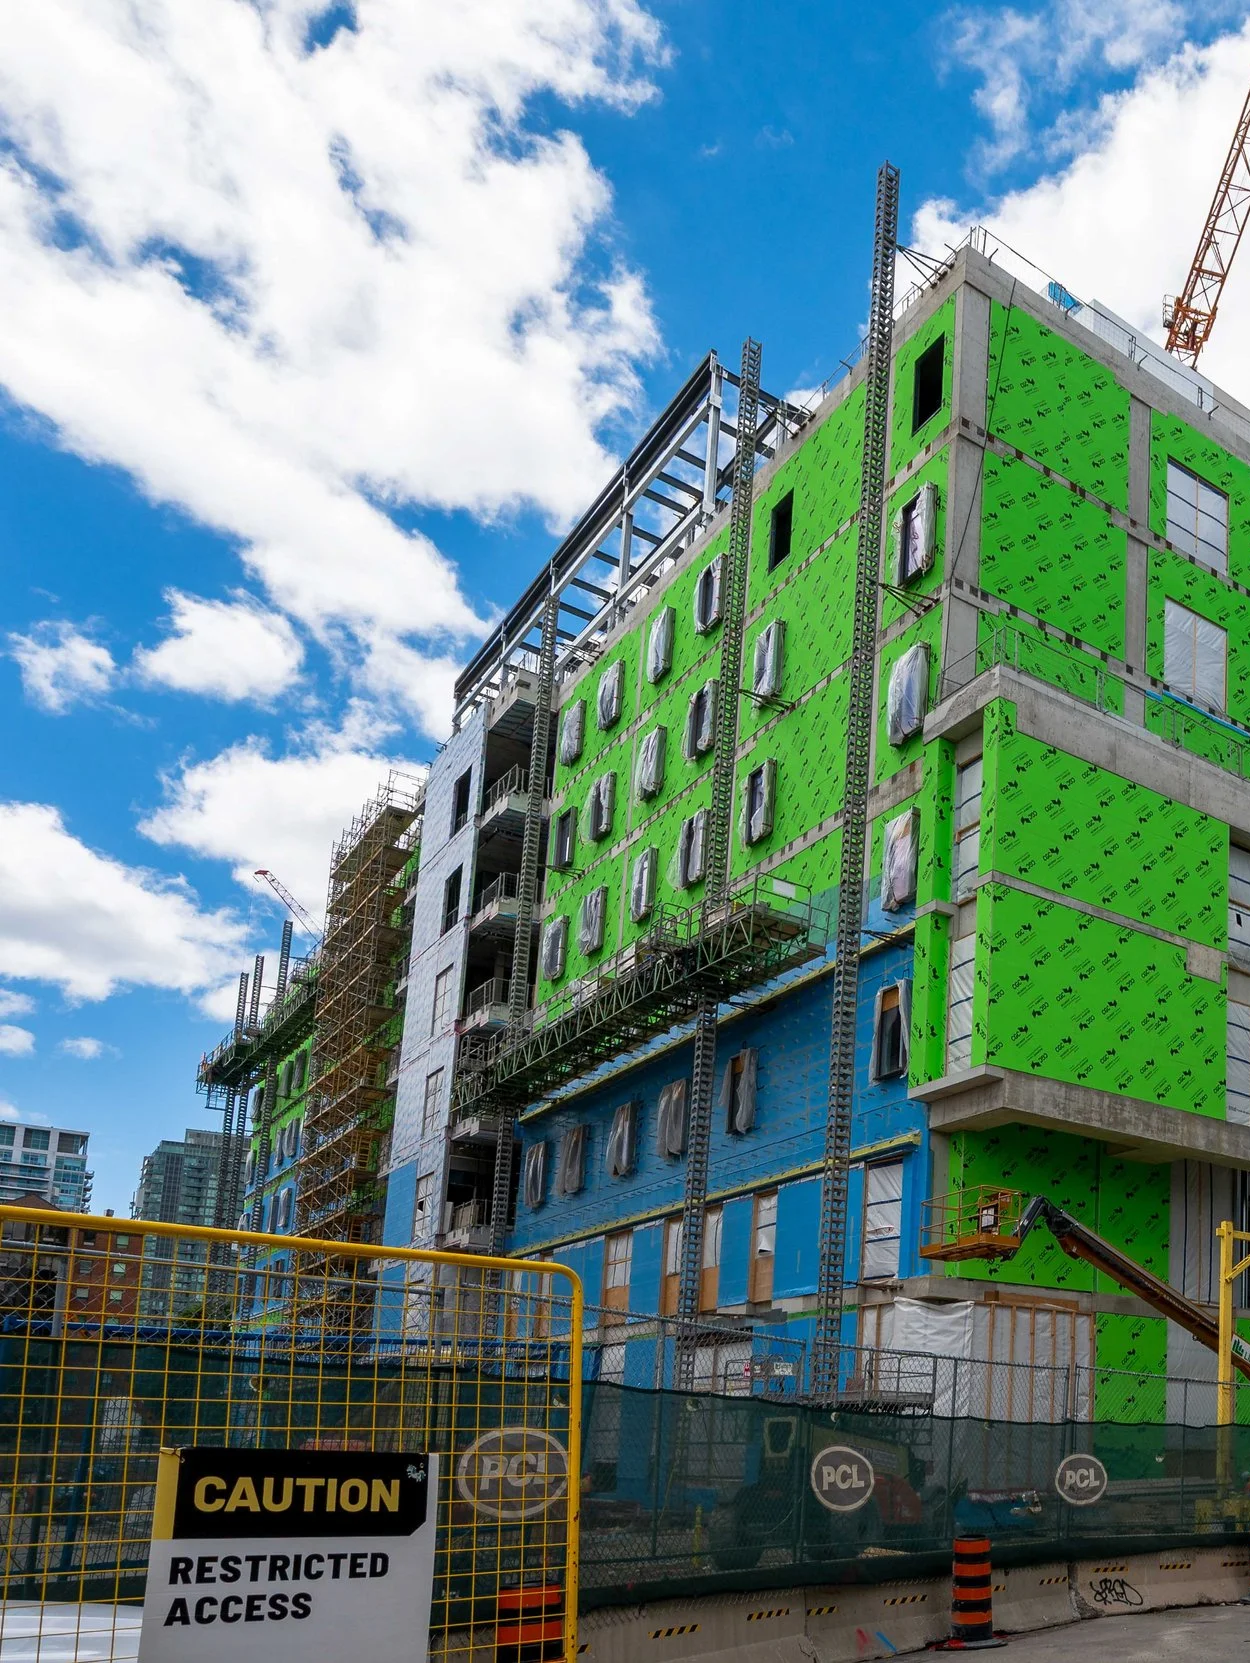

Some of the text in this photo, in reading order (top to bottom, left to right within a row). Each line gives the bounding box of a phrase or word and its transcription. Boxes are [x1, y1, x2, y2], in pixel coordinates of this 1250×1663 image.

[480, 1451, 549, 1492] PCL
[822, 1464, 865, 1491] PCL
[1064, 1467, 1100, 1490] PCL
[194, 1476, 401, 1513] CAUTION
[168, 1552, 390, 1587] RESTRICTED
[164, 1592, 313, 1628] ACCESS
